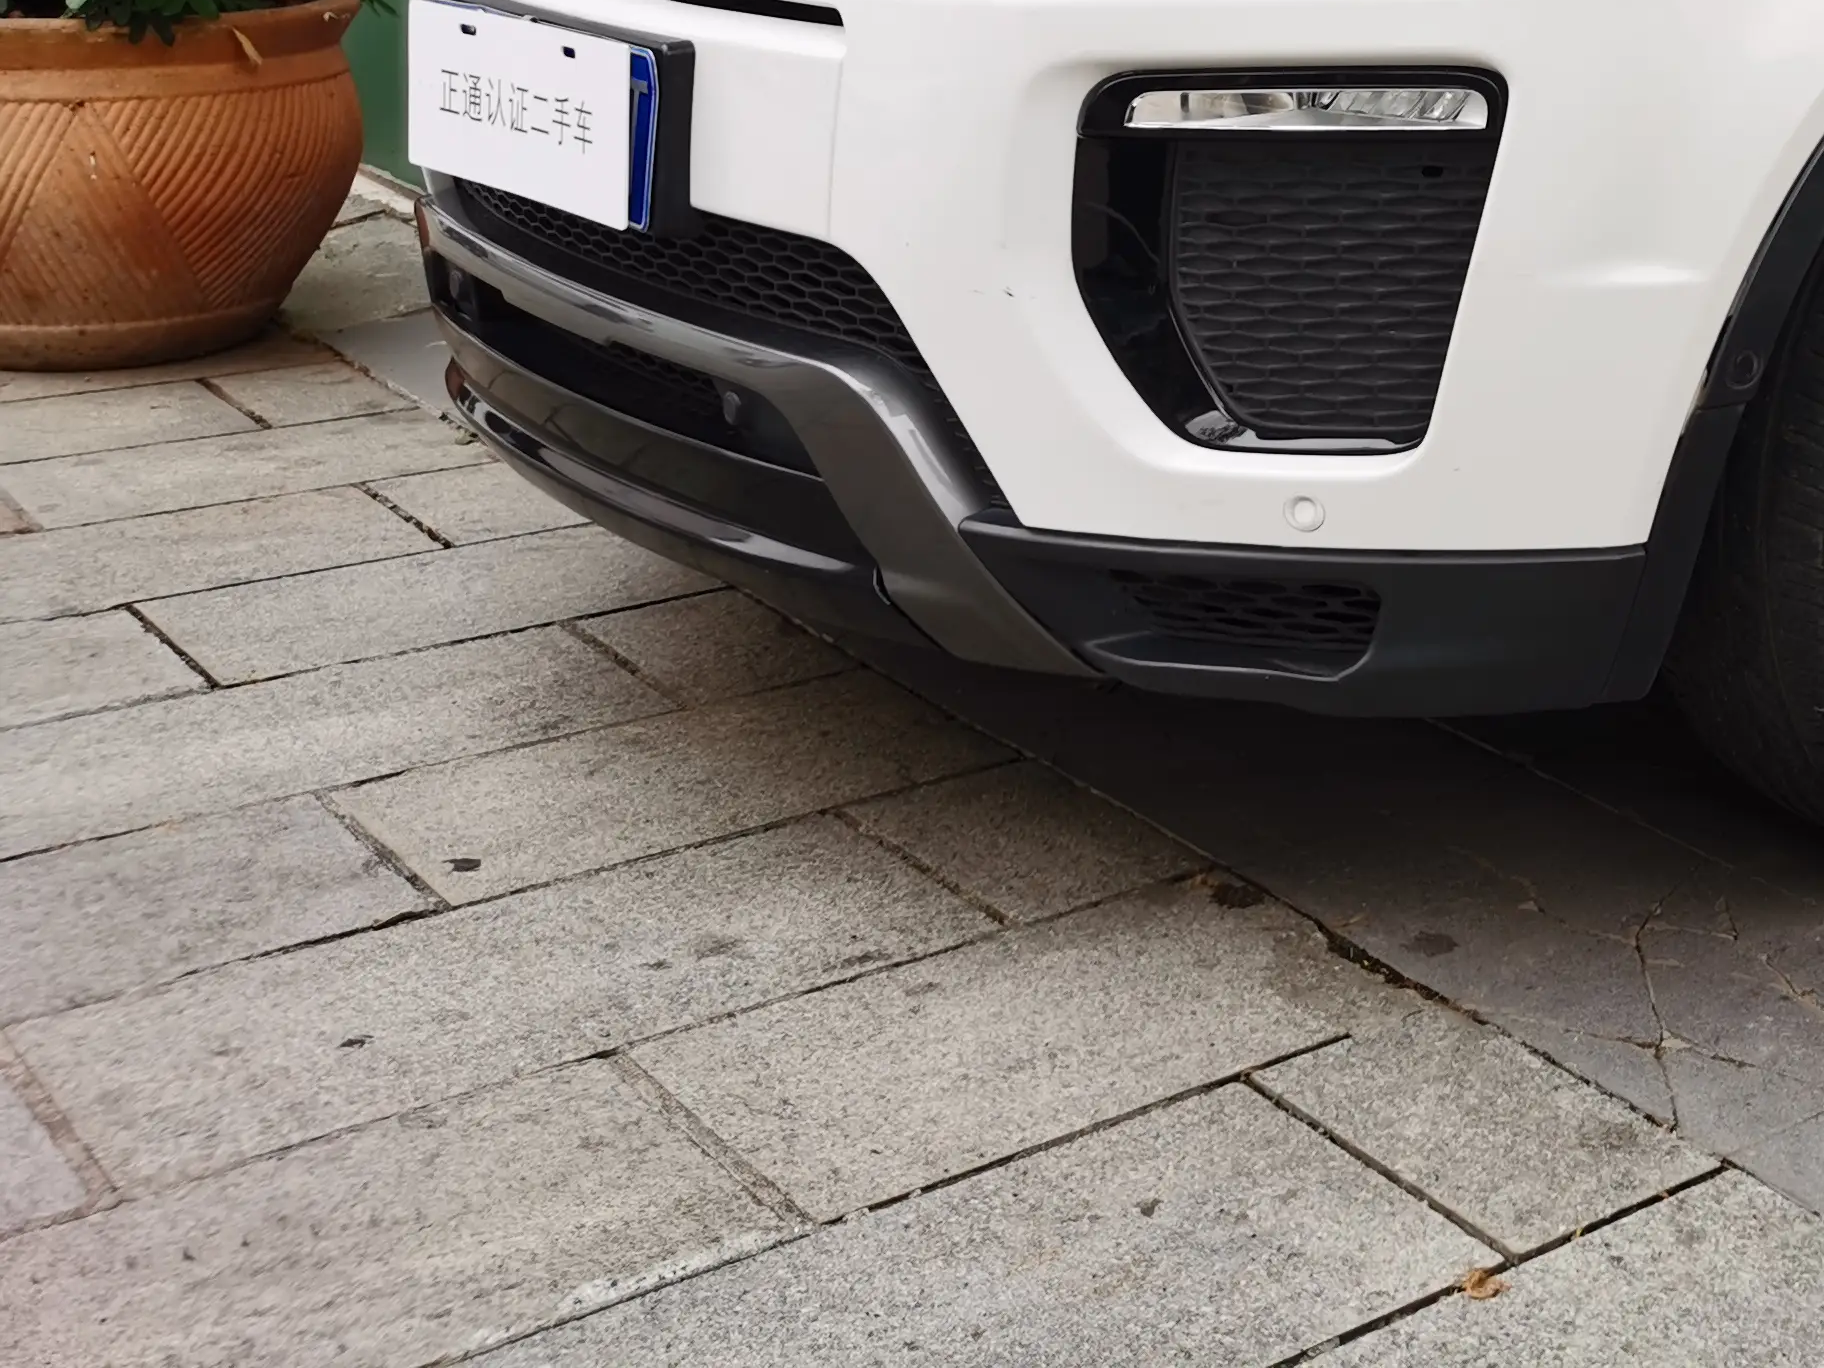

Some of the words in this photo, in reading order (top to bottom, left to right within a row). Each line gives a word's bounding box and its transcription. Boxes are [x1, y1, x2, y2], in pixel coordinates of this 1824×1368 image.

[439, 69, 593, 154] 正通认证二手车
